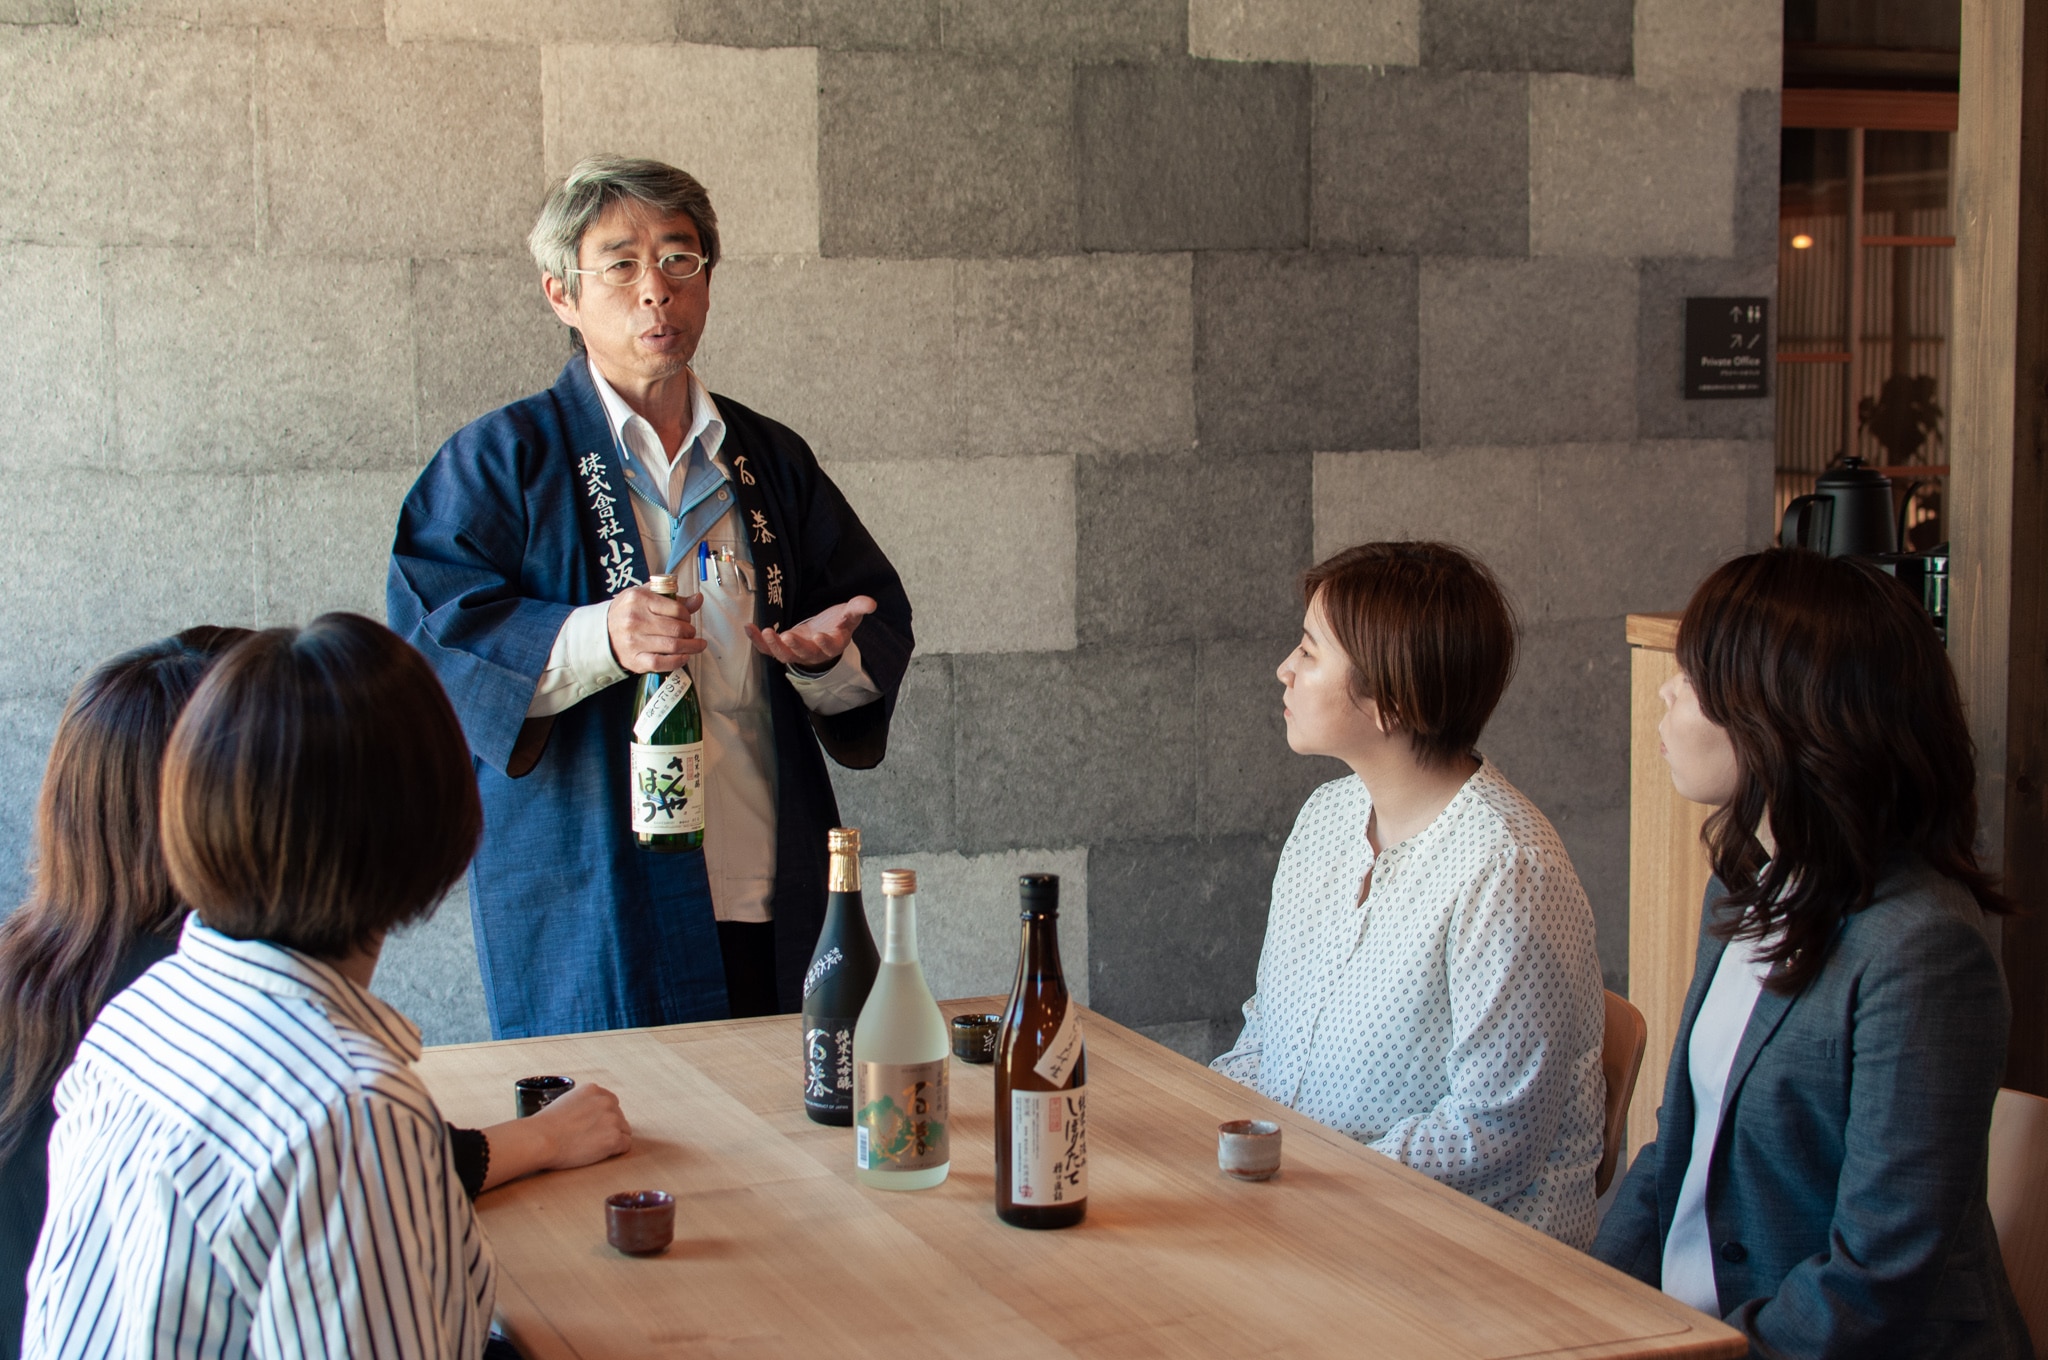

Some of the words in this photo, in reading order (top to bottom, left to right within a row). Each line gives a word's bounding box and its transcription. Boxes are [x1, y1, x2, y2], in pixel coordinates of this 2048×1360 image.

[1701, 356, 1732, 367] Private
[1733, 356, 1761, 367] Office
[578, 452, 643, 598] 株式會社小坂
[1065, 1096, 1080, 1186] しぼりたて
